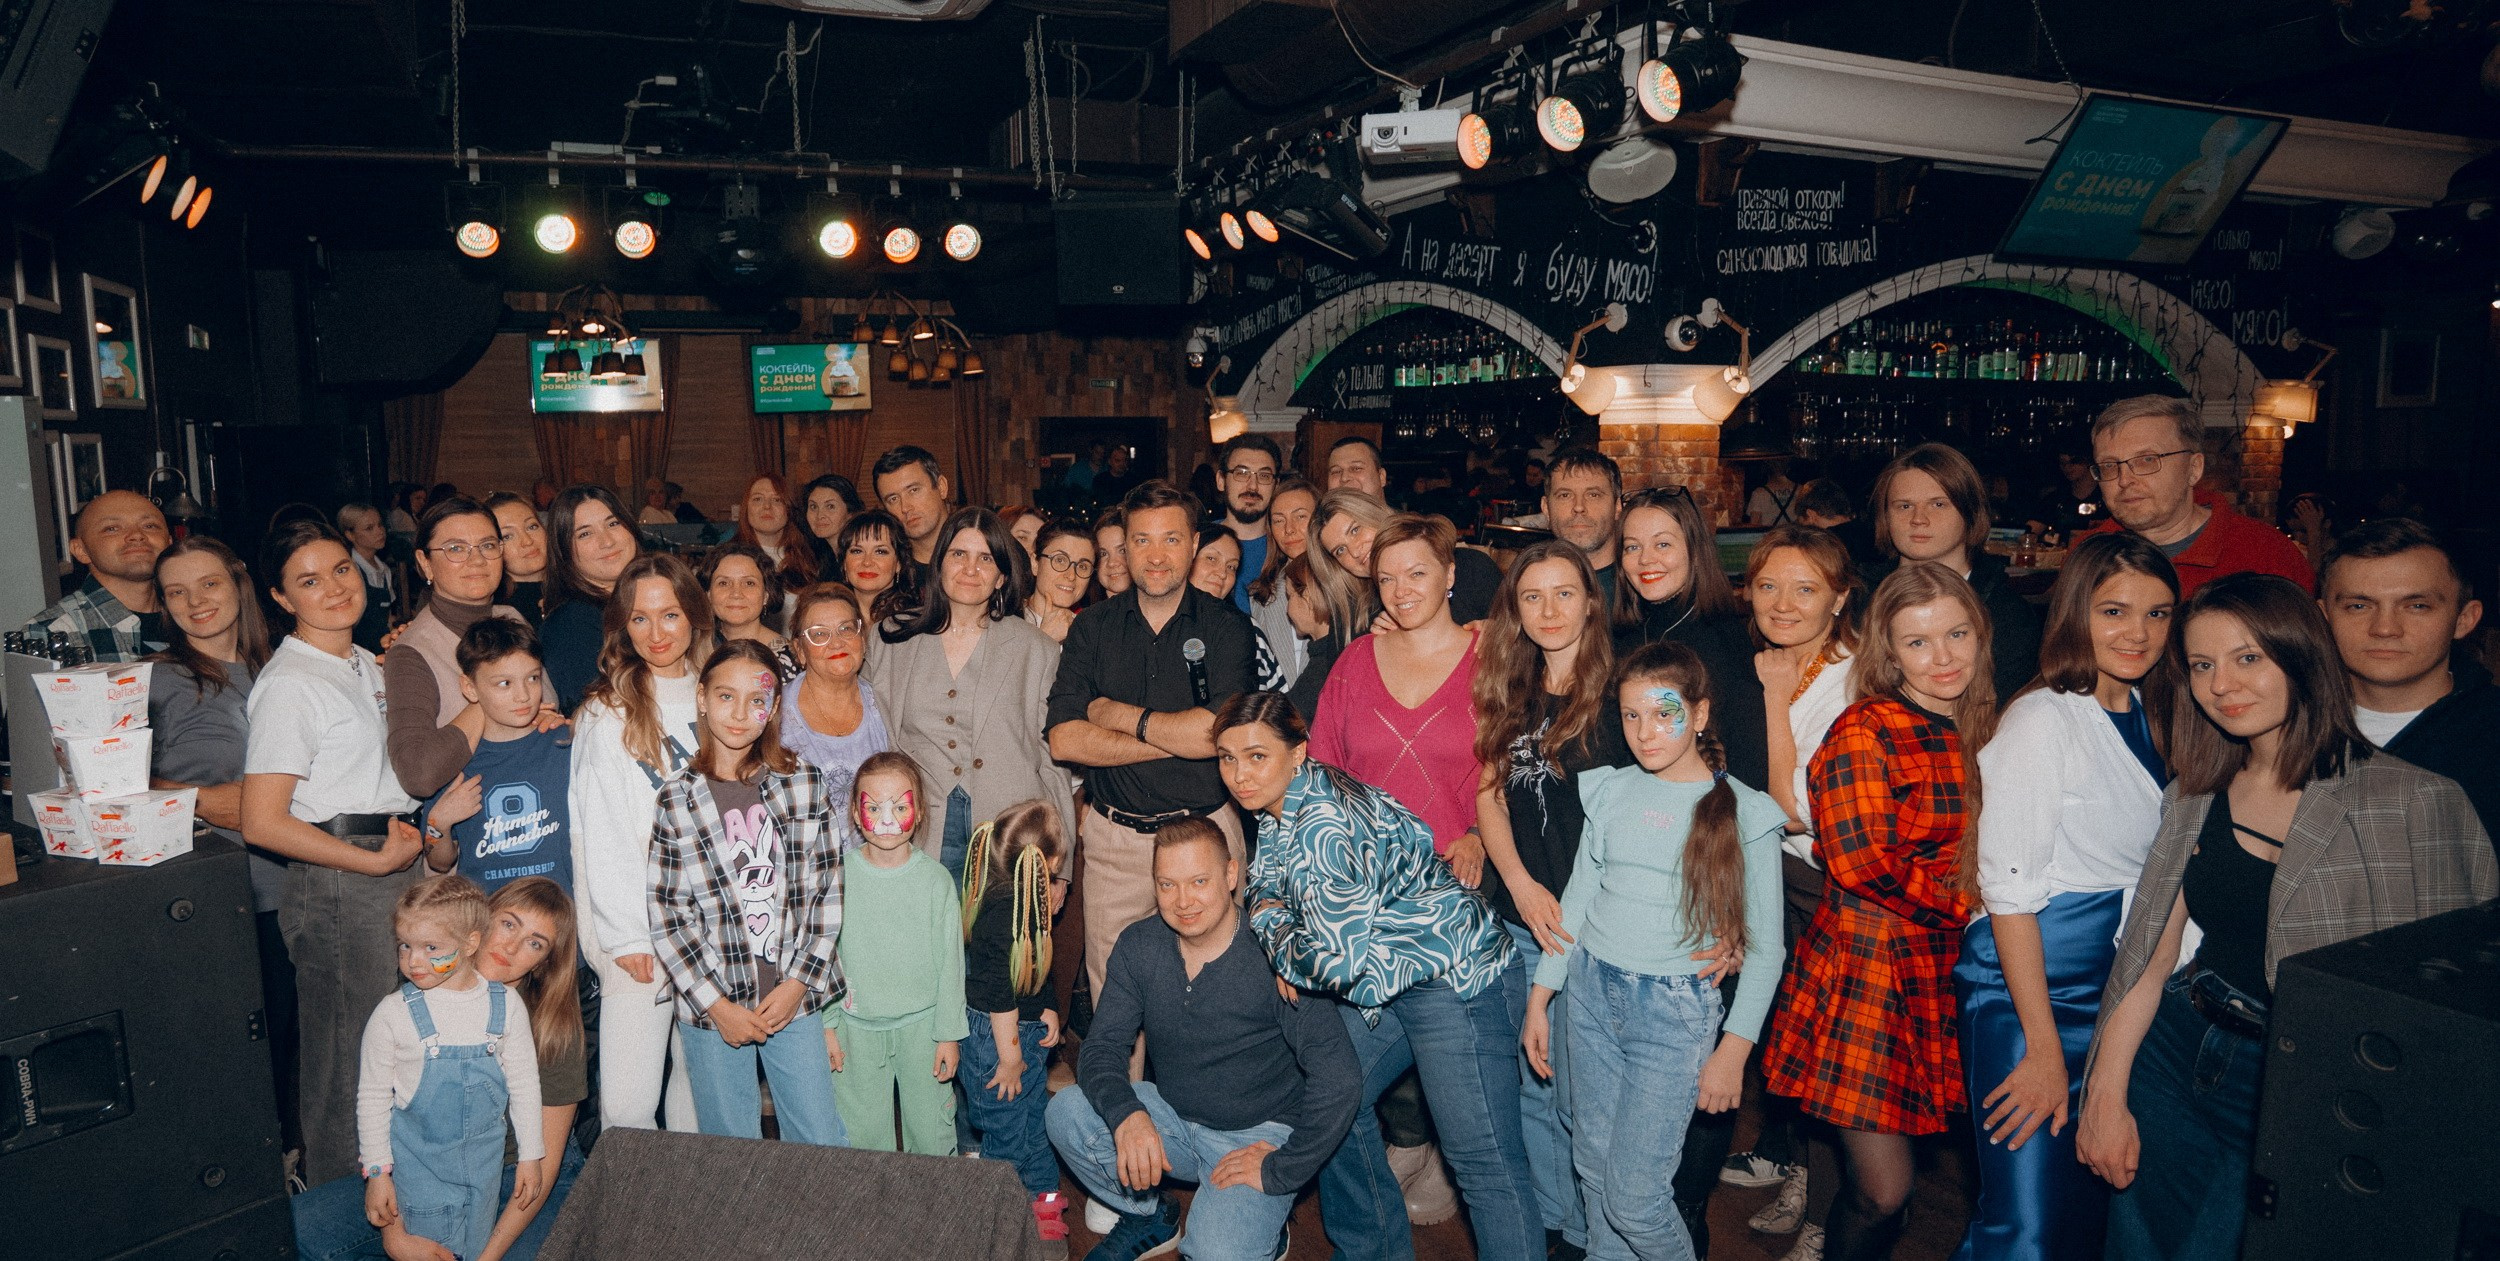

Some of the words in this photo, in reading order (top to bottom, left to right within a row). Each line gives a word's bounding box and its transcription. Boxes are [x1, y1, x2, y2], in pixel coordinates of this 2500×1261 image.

[1401, 222, 1412, 270] А
[760, 363, 815, 374] КОКТЕЙЛЬ
[760, 383, 816, 393] рождения!
[51, 683, 81, 692] Raffaello
[107, 683, 148, 700] Raffaello
[93, 742, 133, 755] Raffaello
[38, 811, 77, 826] Raffaello
[483, 808, 550, 840] Human
[91, 820, 137, 833] Raffaello
[475, 821, 560, 858] Connection
[484, 862, 556, 880] CHAMPIONSHIP
